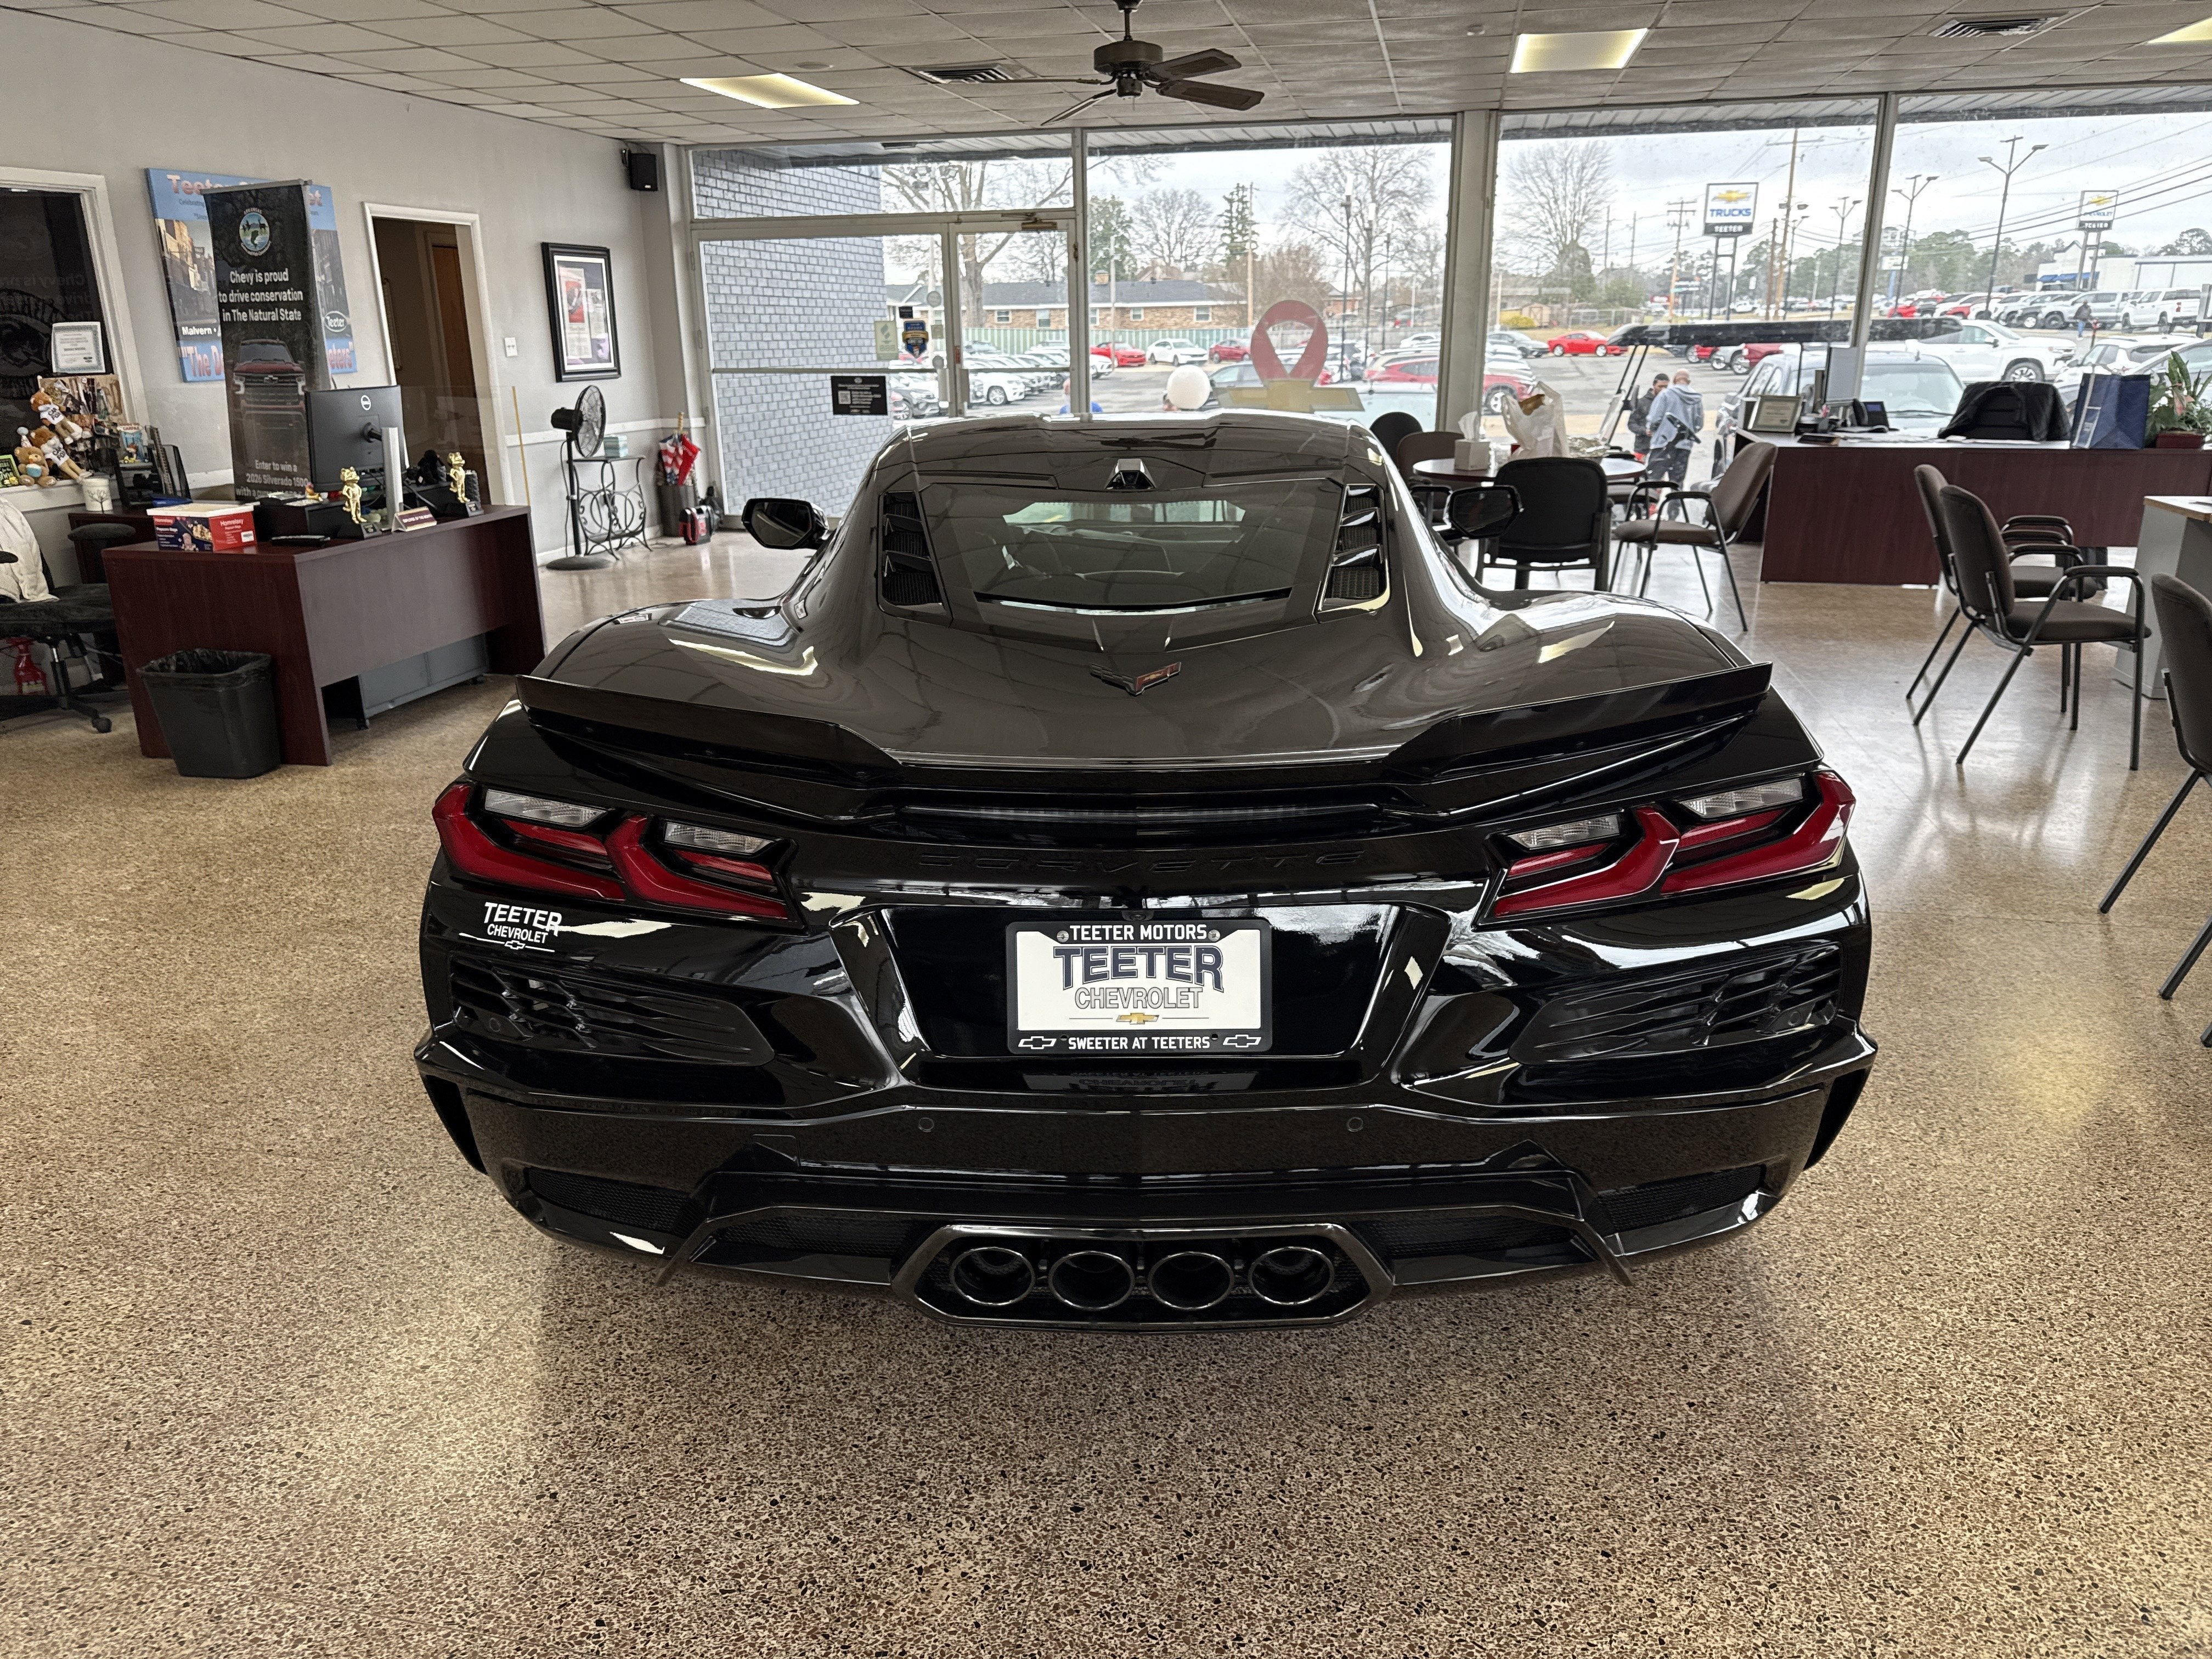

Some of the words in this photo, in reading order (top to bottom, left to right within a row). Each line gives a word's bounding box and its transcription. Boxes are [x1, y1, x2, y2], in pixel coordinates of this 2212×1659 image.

[1709, 208, 1751, 217] TRUCKS
[230, 270, 253, 285] Chevy
[254, 269, 263, 283] is
[264, 268, 289, 285] proud
[218, 291, 228, 303] to
[229, 289, 250, 302] drive
[250, 287, 303, 302] conservation
[222, 308, 231, 322] in
[232, 308, 247, 322] The
[249, 307, 279, 321] Natural
[280, 308, 302, 321] State
[182, 326, 212, 336] Malvern
[255, 460, 272, 471] Enter
[272, 461, 280, 471] to
[280, 461, 292, 472] win
[293, 464, 297, 472] a
[246, 472, 263, 483] 2026
[263, 474, 292, 487] Silverado
[919, 850, 1365, 873] CORVETTE
[484, 902, 562, 936] TEETER
[487, 923, 549, 944] CHEVROLET
[1069, 925, 1134, 941] TEETER
[1140, 924, 1207, 940] MOTORS
[1053, 945, 1224, 993] TEETER
[1075, 987, 1203, 1009] CHEVROLET
[1068, 1037, 1130, 1049] SWEETER
[1132, 1037, 1148, 1049] AT
[1152, 1036, 1210, 1049] TEETERS
